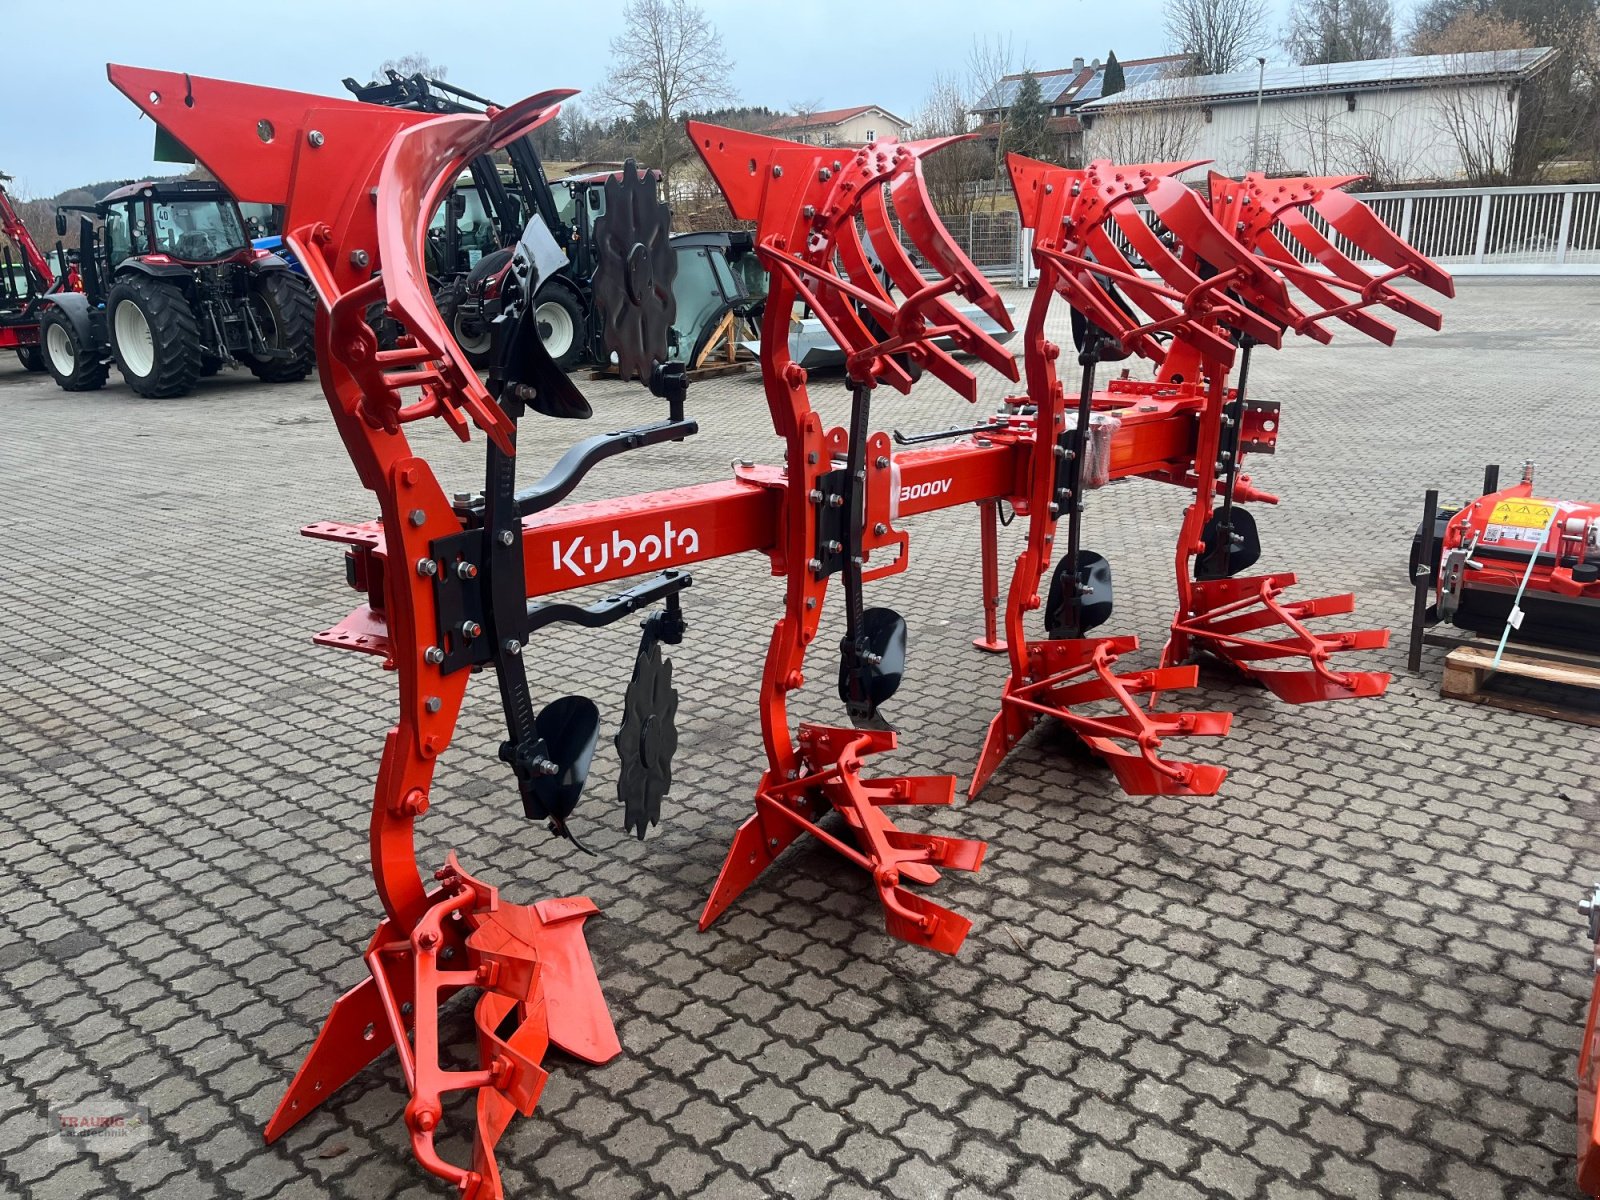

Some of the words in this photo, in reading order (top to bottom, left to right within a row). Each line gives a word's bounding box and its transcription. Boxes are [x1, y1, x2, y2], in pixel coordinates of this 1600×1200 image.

[159, 211, 168, 221] 40
[899, 477, 953, 502] 3000V
[552, 520, 699, 577] Kubota
